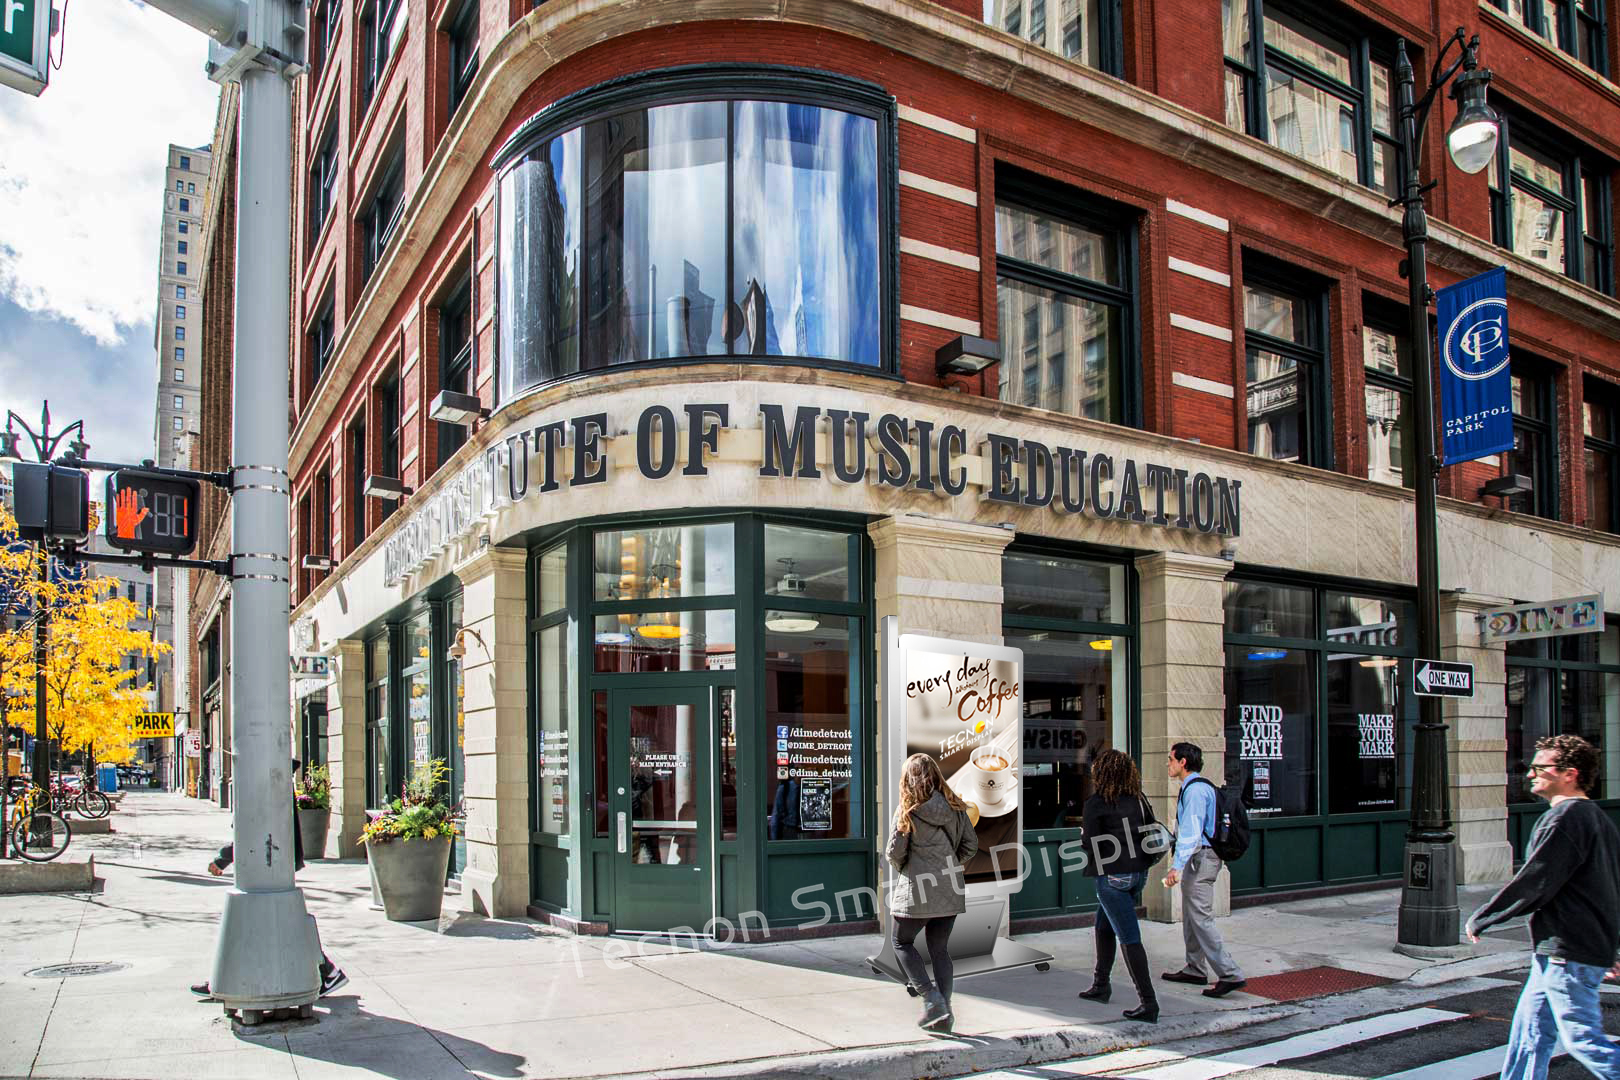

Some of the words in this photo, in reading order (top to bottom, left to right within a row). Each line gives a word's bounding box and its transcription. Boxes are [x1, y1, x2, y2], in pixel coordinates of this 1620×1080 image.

[1446, 405, 1510, 428] CAPITOL
[1446, 421, 1484, 438] PARK
[636, 402, 730, 480] OF
[759, 403, 968, 497] MUSIC
[987, 432, 1242, 538] EDUCATION
[1488, 600, 1598, 637] DIME
[906, 669, 953, 709] every
[957, 655, 992, 690] day
[1428, 670, 1447, 686] ONE
[1448, 671, 1468, 687] WAY
[957, 677, 1019, 722] Coffee
[1240, 704, 1284, 722] FIND
[1359, 713, 1394, 728] MAKE
[135, 714, 171, 730] PARK
[790, 727, 853, 739] /dimedetroit
[1240, 722, 1284, 740] YOUR
[1359, 728, 1395, 742] YOUR
[787, 742, 853, 751] @DIME_DETROIT
[938, 743, 965, 762] SMART
[966, 728, 993, 747] DISPLAY
[1240, 739, 1284, 757] PATH
[1359, 741, 1395, 755] MARK
[789, 753, 853, 765] /dimedetroit
[789, 768, 853, 778] @dime_detroit
